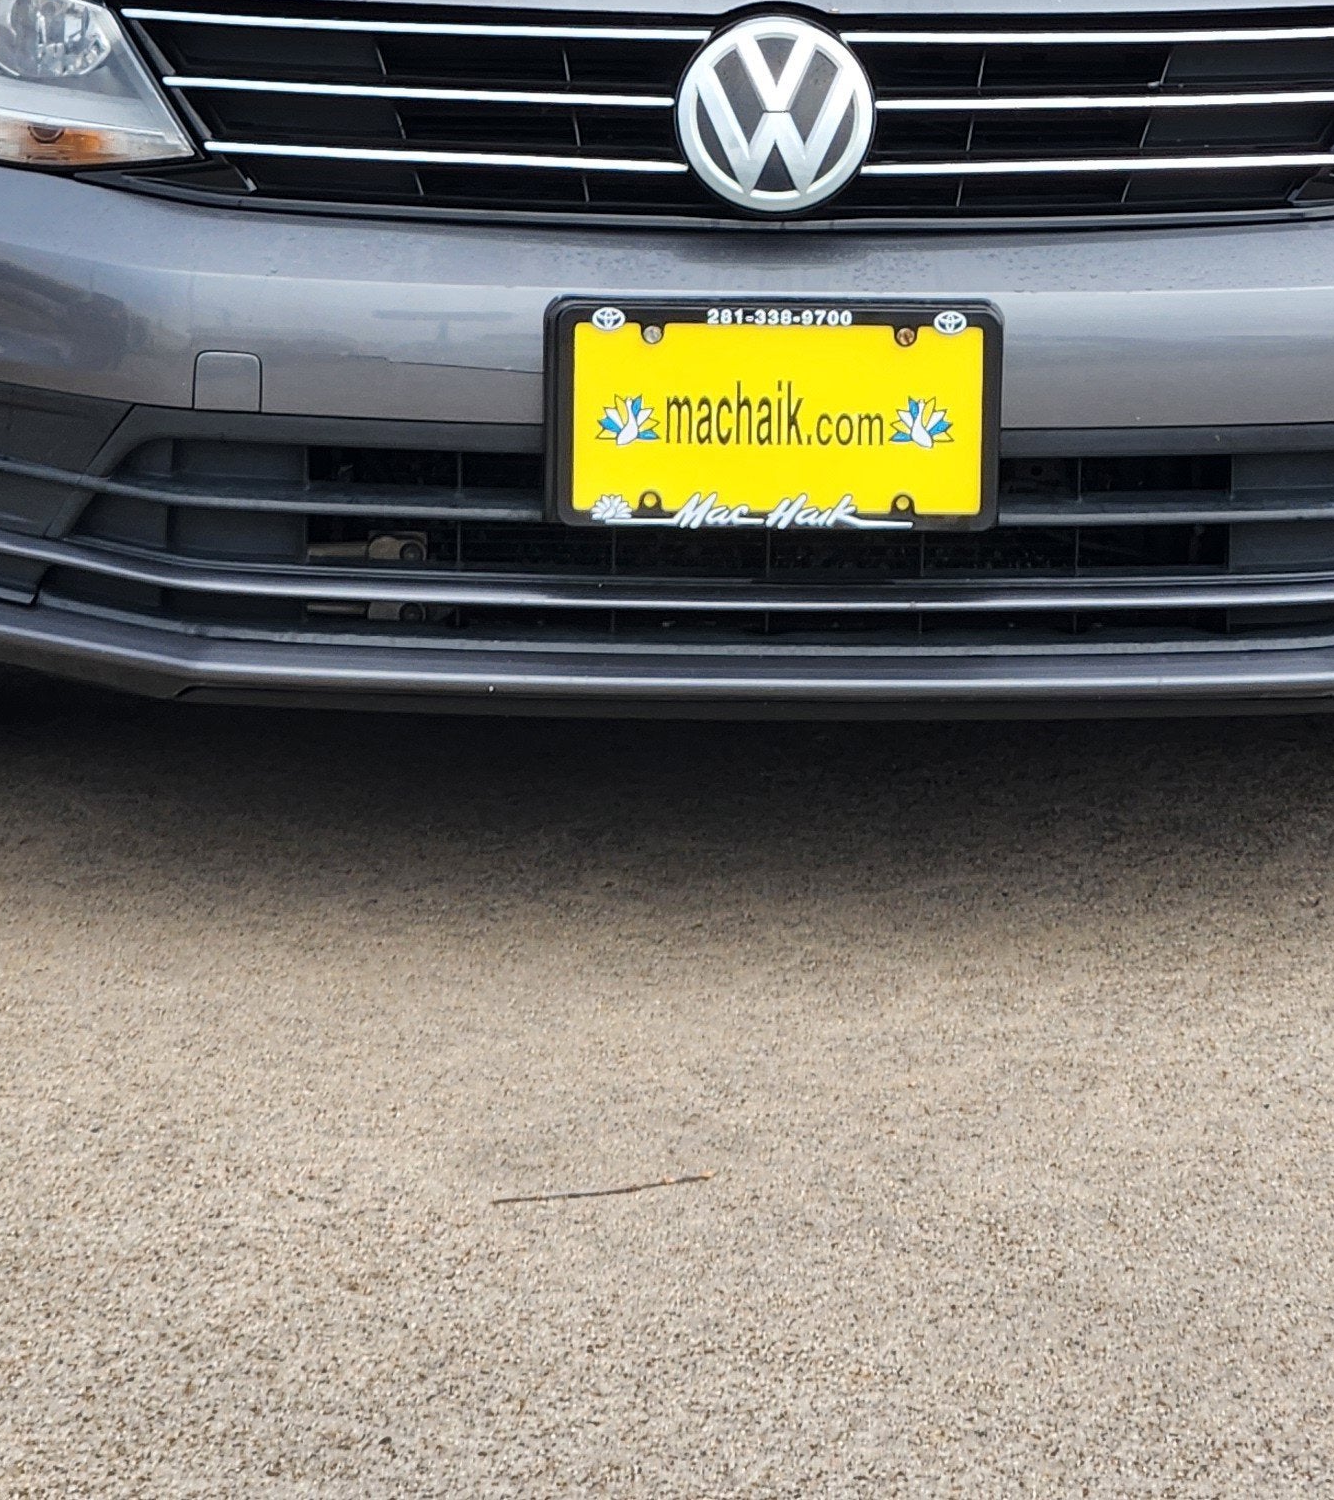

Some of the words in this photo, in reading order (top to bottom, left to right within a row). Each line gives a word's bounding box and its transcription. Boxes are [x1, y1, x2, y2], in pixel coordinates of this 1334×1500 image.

[706, 307, 854, 326] 281-338-9700
[665, 380, 885, 447] machaik.com
[673, 491, 757, 530] Mac
